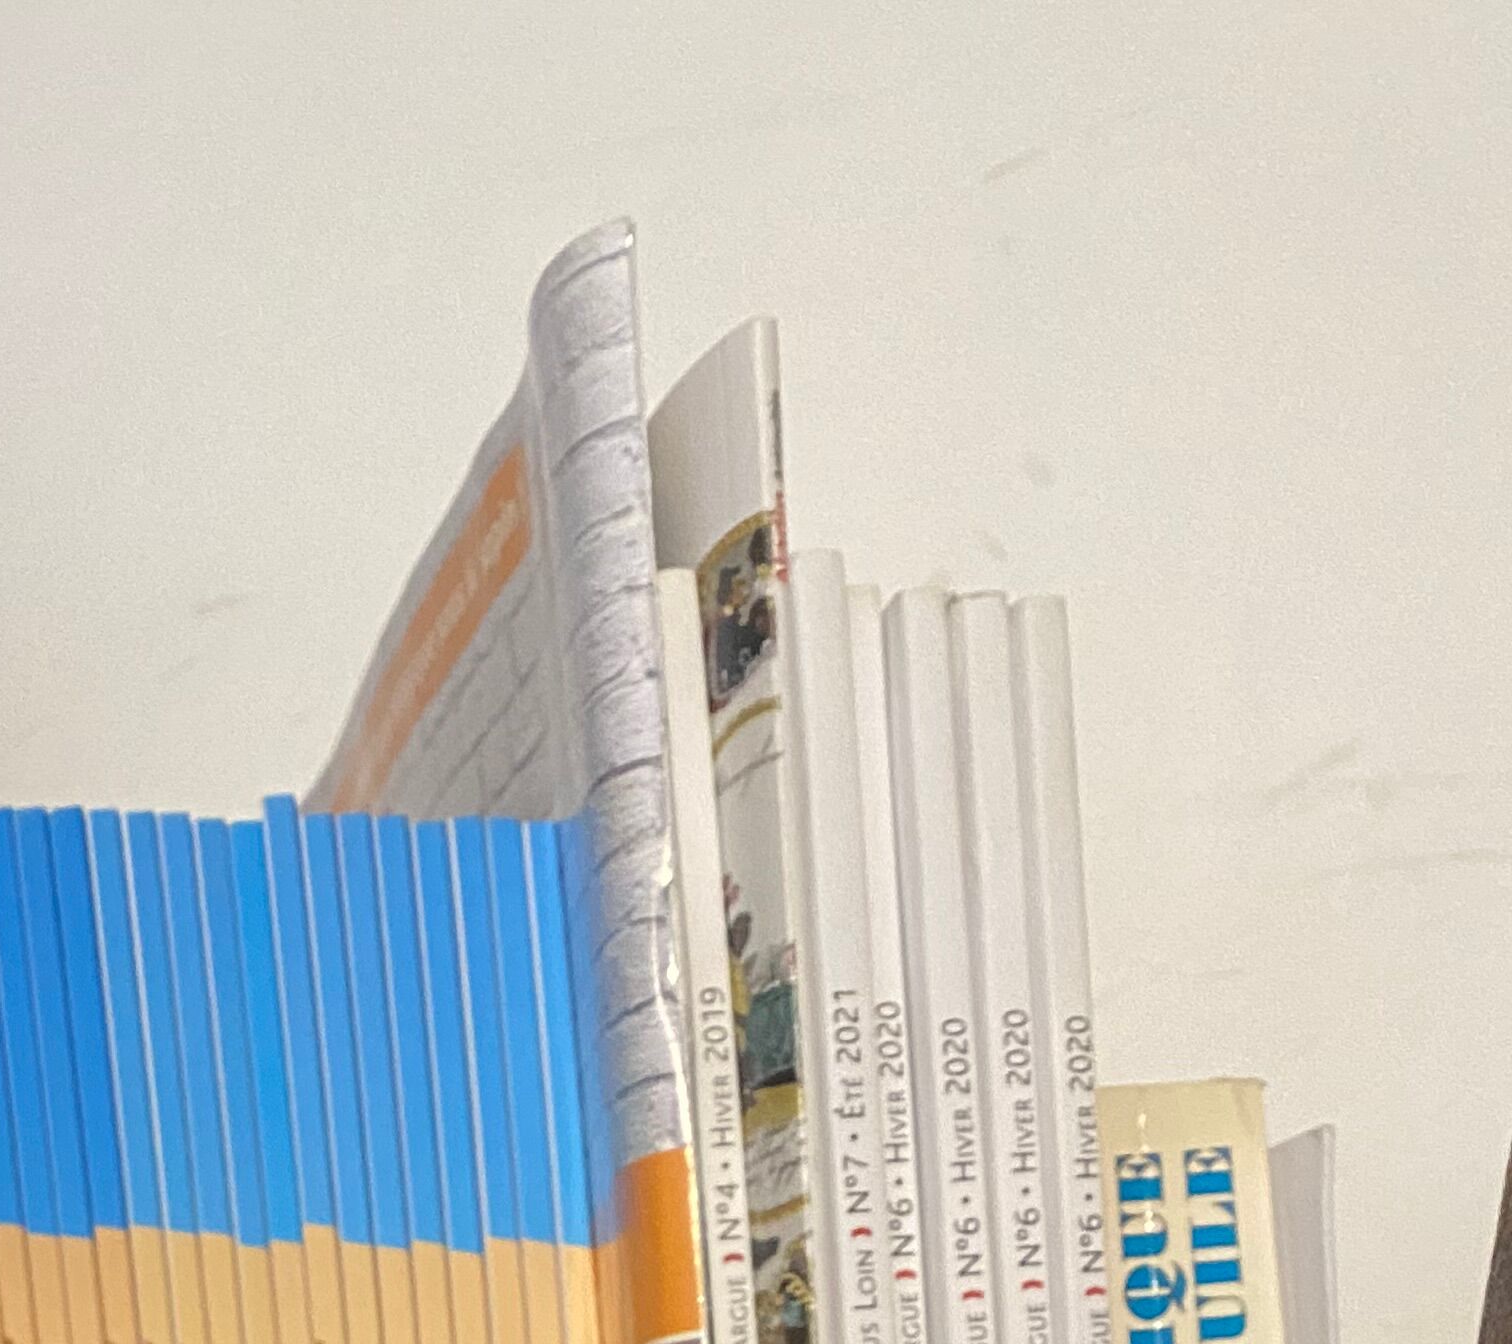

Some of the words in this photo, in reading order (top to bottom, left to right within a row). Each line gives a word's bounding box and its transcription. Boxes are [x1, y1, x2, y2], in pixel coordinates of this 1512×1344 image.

[700, 986, 731, 1062] 2019
[833, 987, 863, 1072] 2021
[878, 1000, 906, 1078] 2020
[941, 1016, 971, 1096] 2020
[1002, 1008, 1032, 1087] 2020
[1064, 1015, 1092, 1091] 2020
